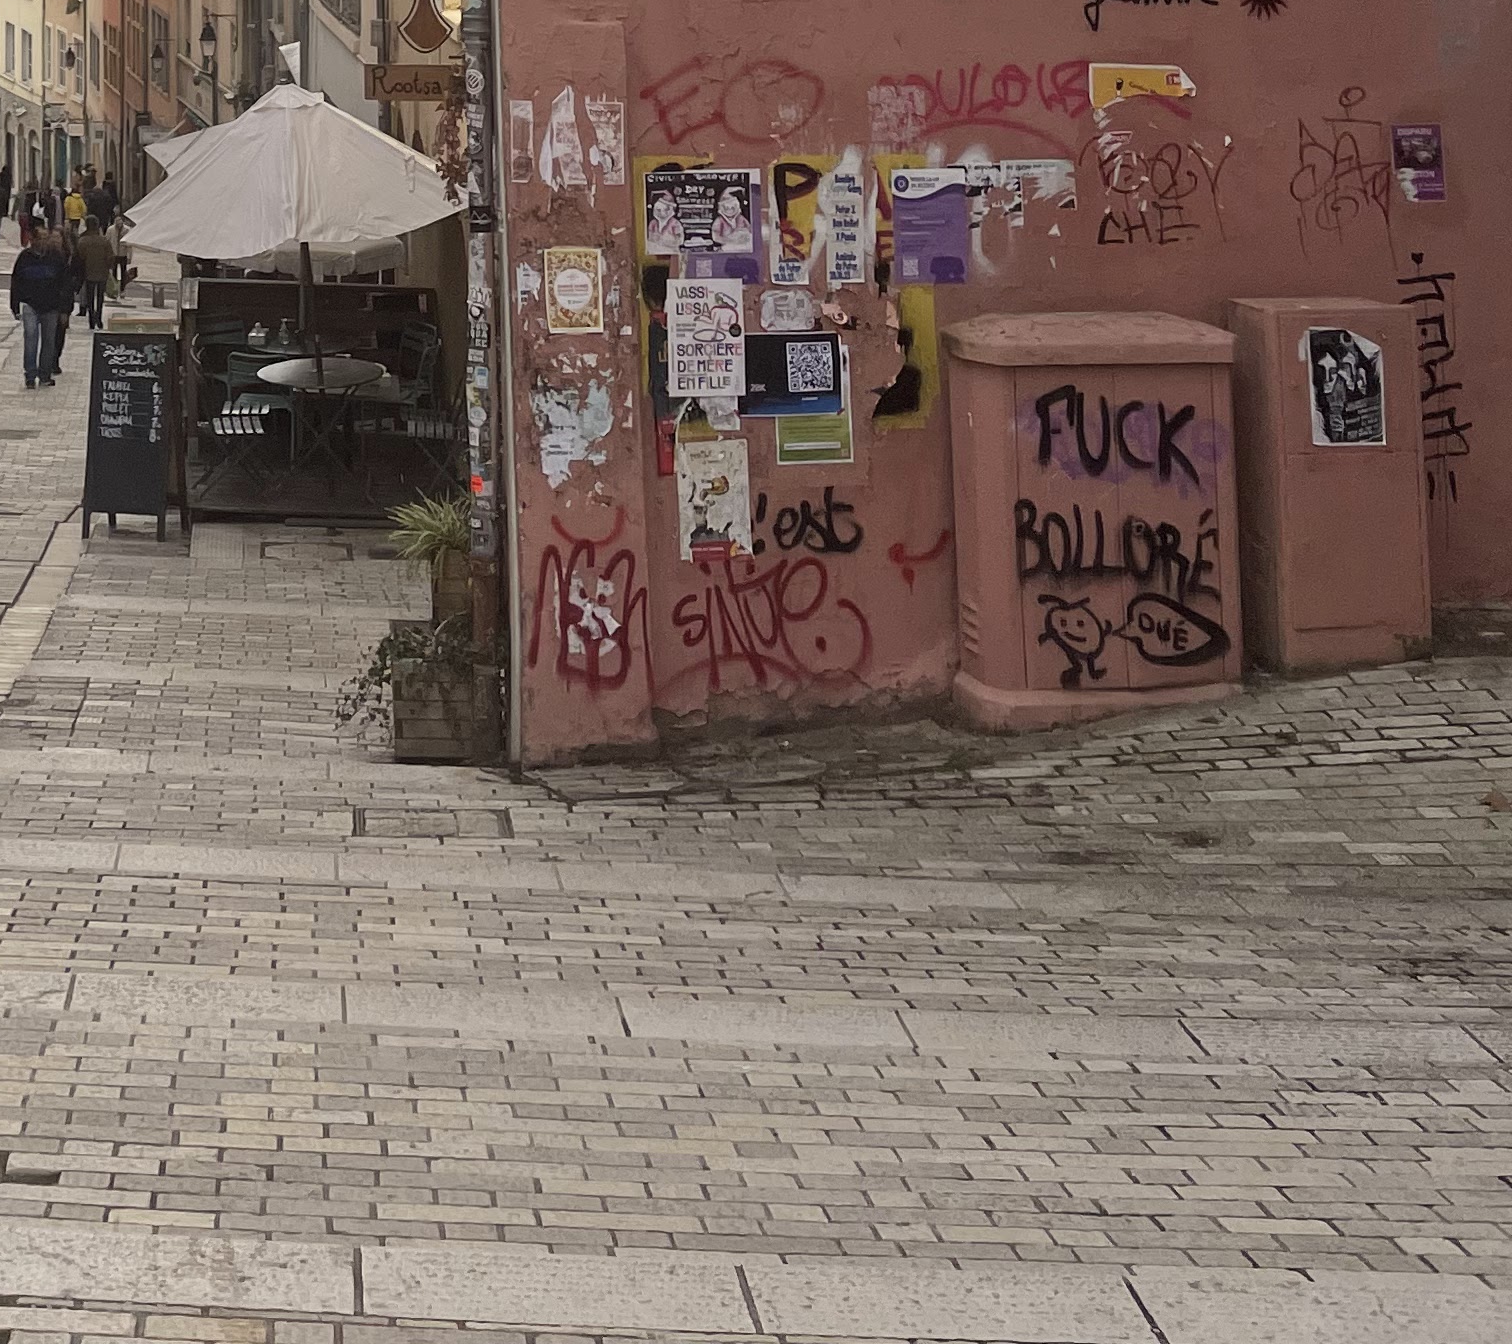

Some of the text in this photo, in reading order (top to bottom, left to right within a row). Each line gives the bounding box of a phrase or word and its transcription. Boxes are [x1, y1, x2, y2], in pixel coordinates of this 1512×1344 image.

[371, 66, 443, 96] Rootsa
[678, 359, 695, 373] DE
[678, 376, 731, 390] EN FILLE
[1036, 385, 1200, 486] FUCK
[1014, 499, 1223, 605] BOLLORÉ
